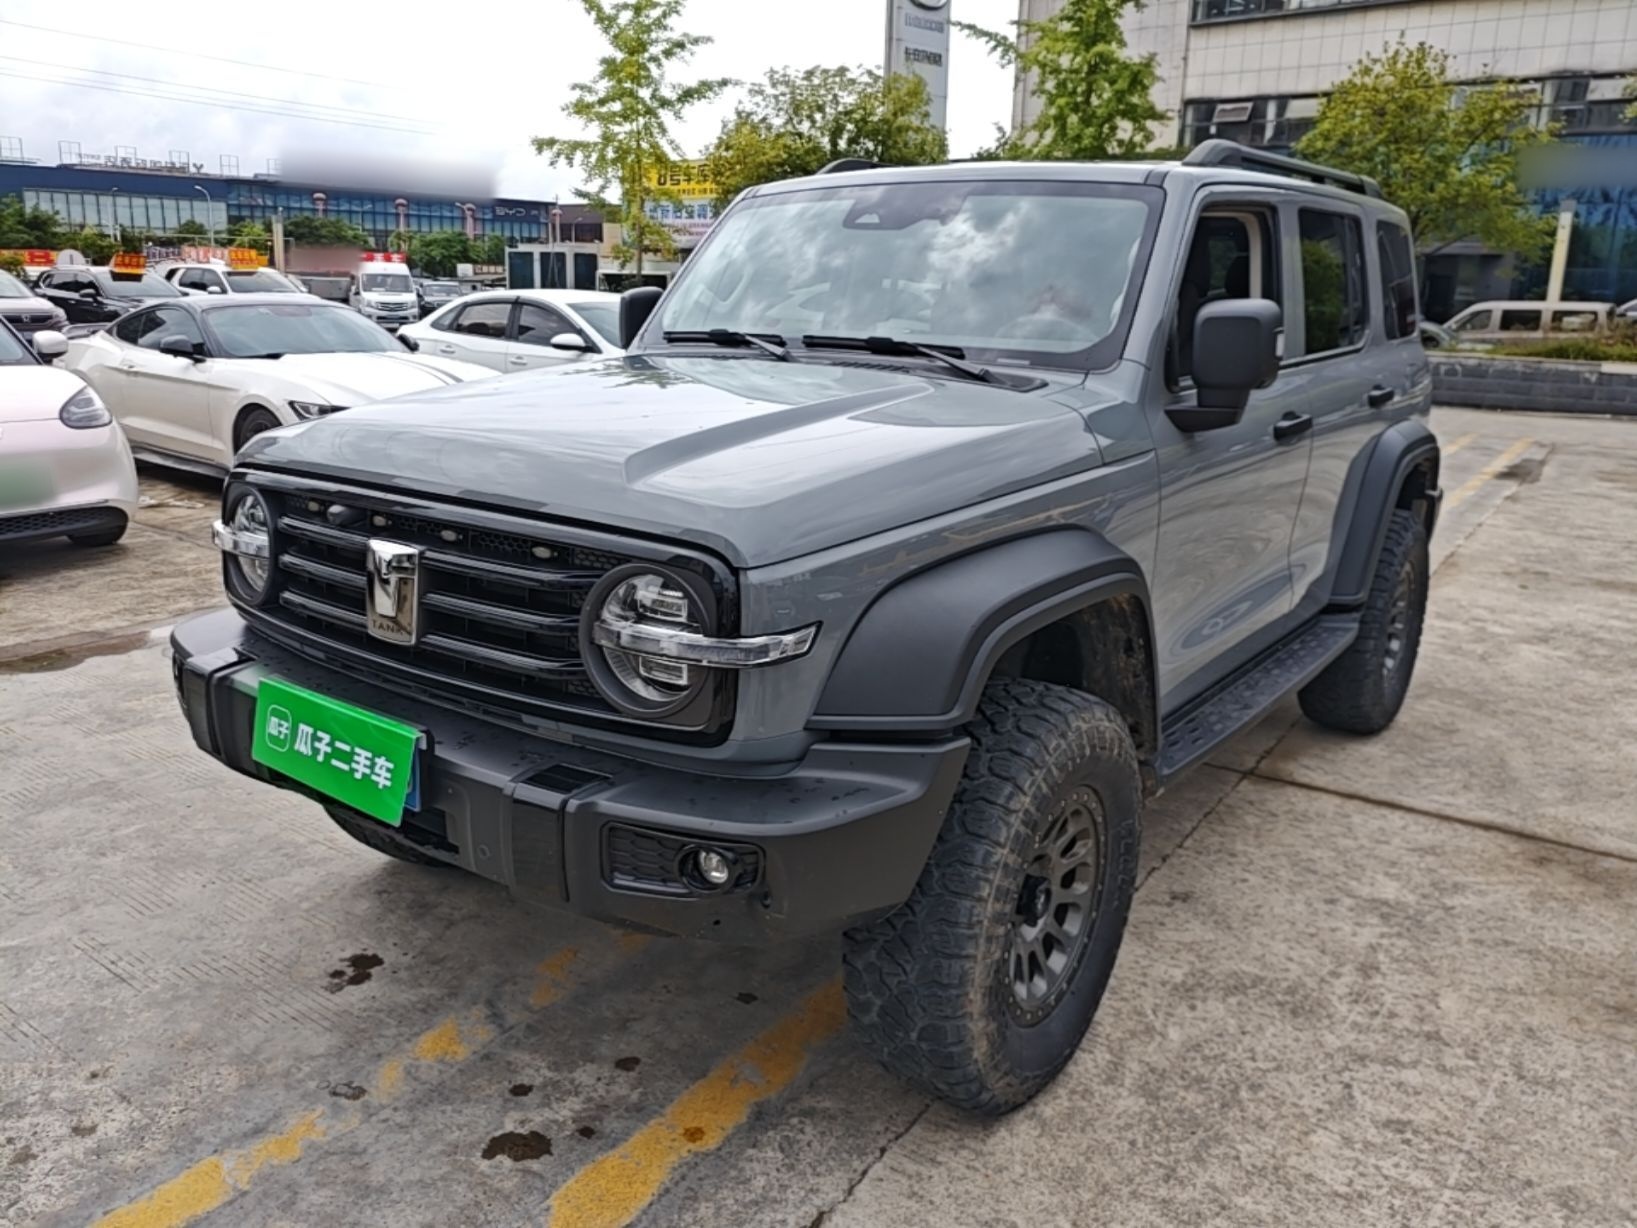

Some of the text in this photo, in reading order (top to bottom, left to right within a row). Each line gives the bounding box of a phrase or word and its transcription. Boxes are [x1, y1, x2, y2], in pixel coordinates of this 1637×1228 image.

[495, 206, 526, 217] BYD
[294, 722, 394, 789] 瓜子二手车
